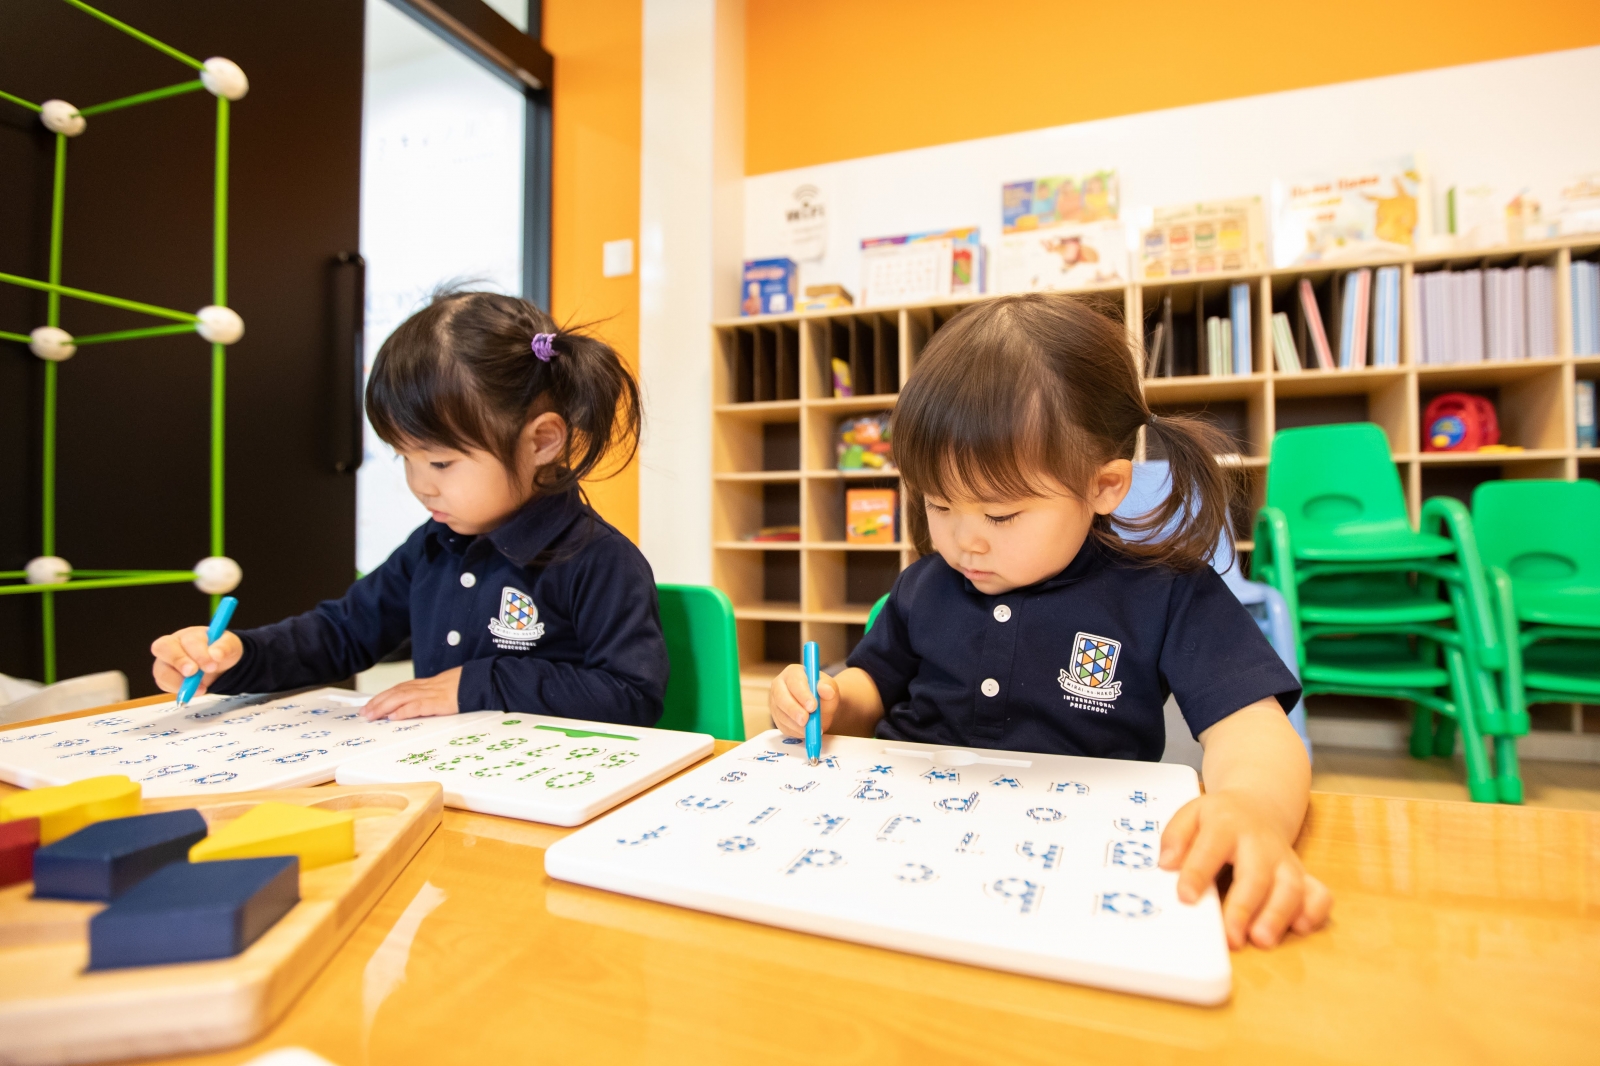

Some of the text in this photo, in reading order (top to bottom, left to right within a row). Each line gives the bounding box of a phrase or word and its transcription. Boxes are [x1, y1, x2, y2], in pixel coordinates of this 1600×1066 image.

[492, 638, 537, 647] INTERNATIONAL
[1063, 695, 1116, 709] INTERNATIONAL
[1069, 702, 1108, 714] PRESCHOOL
